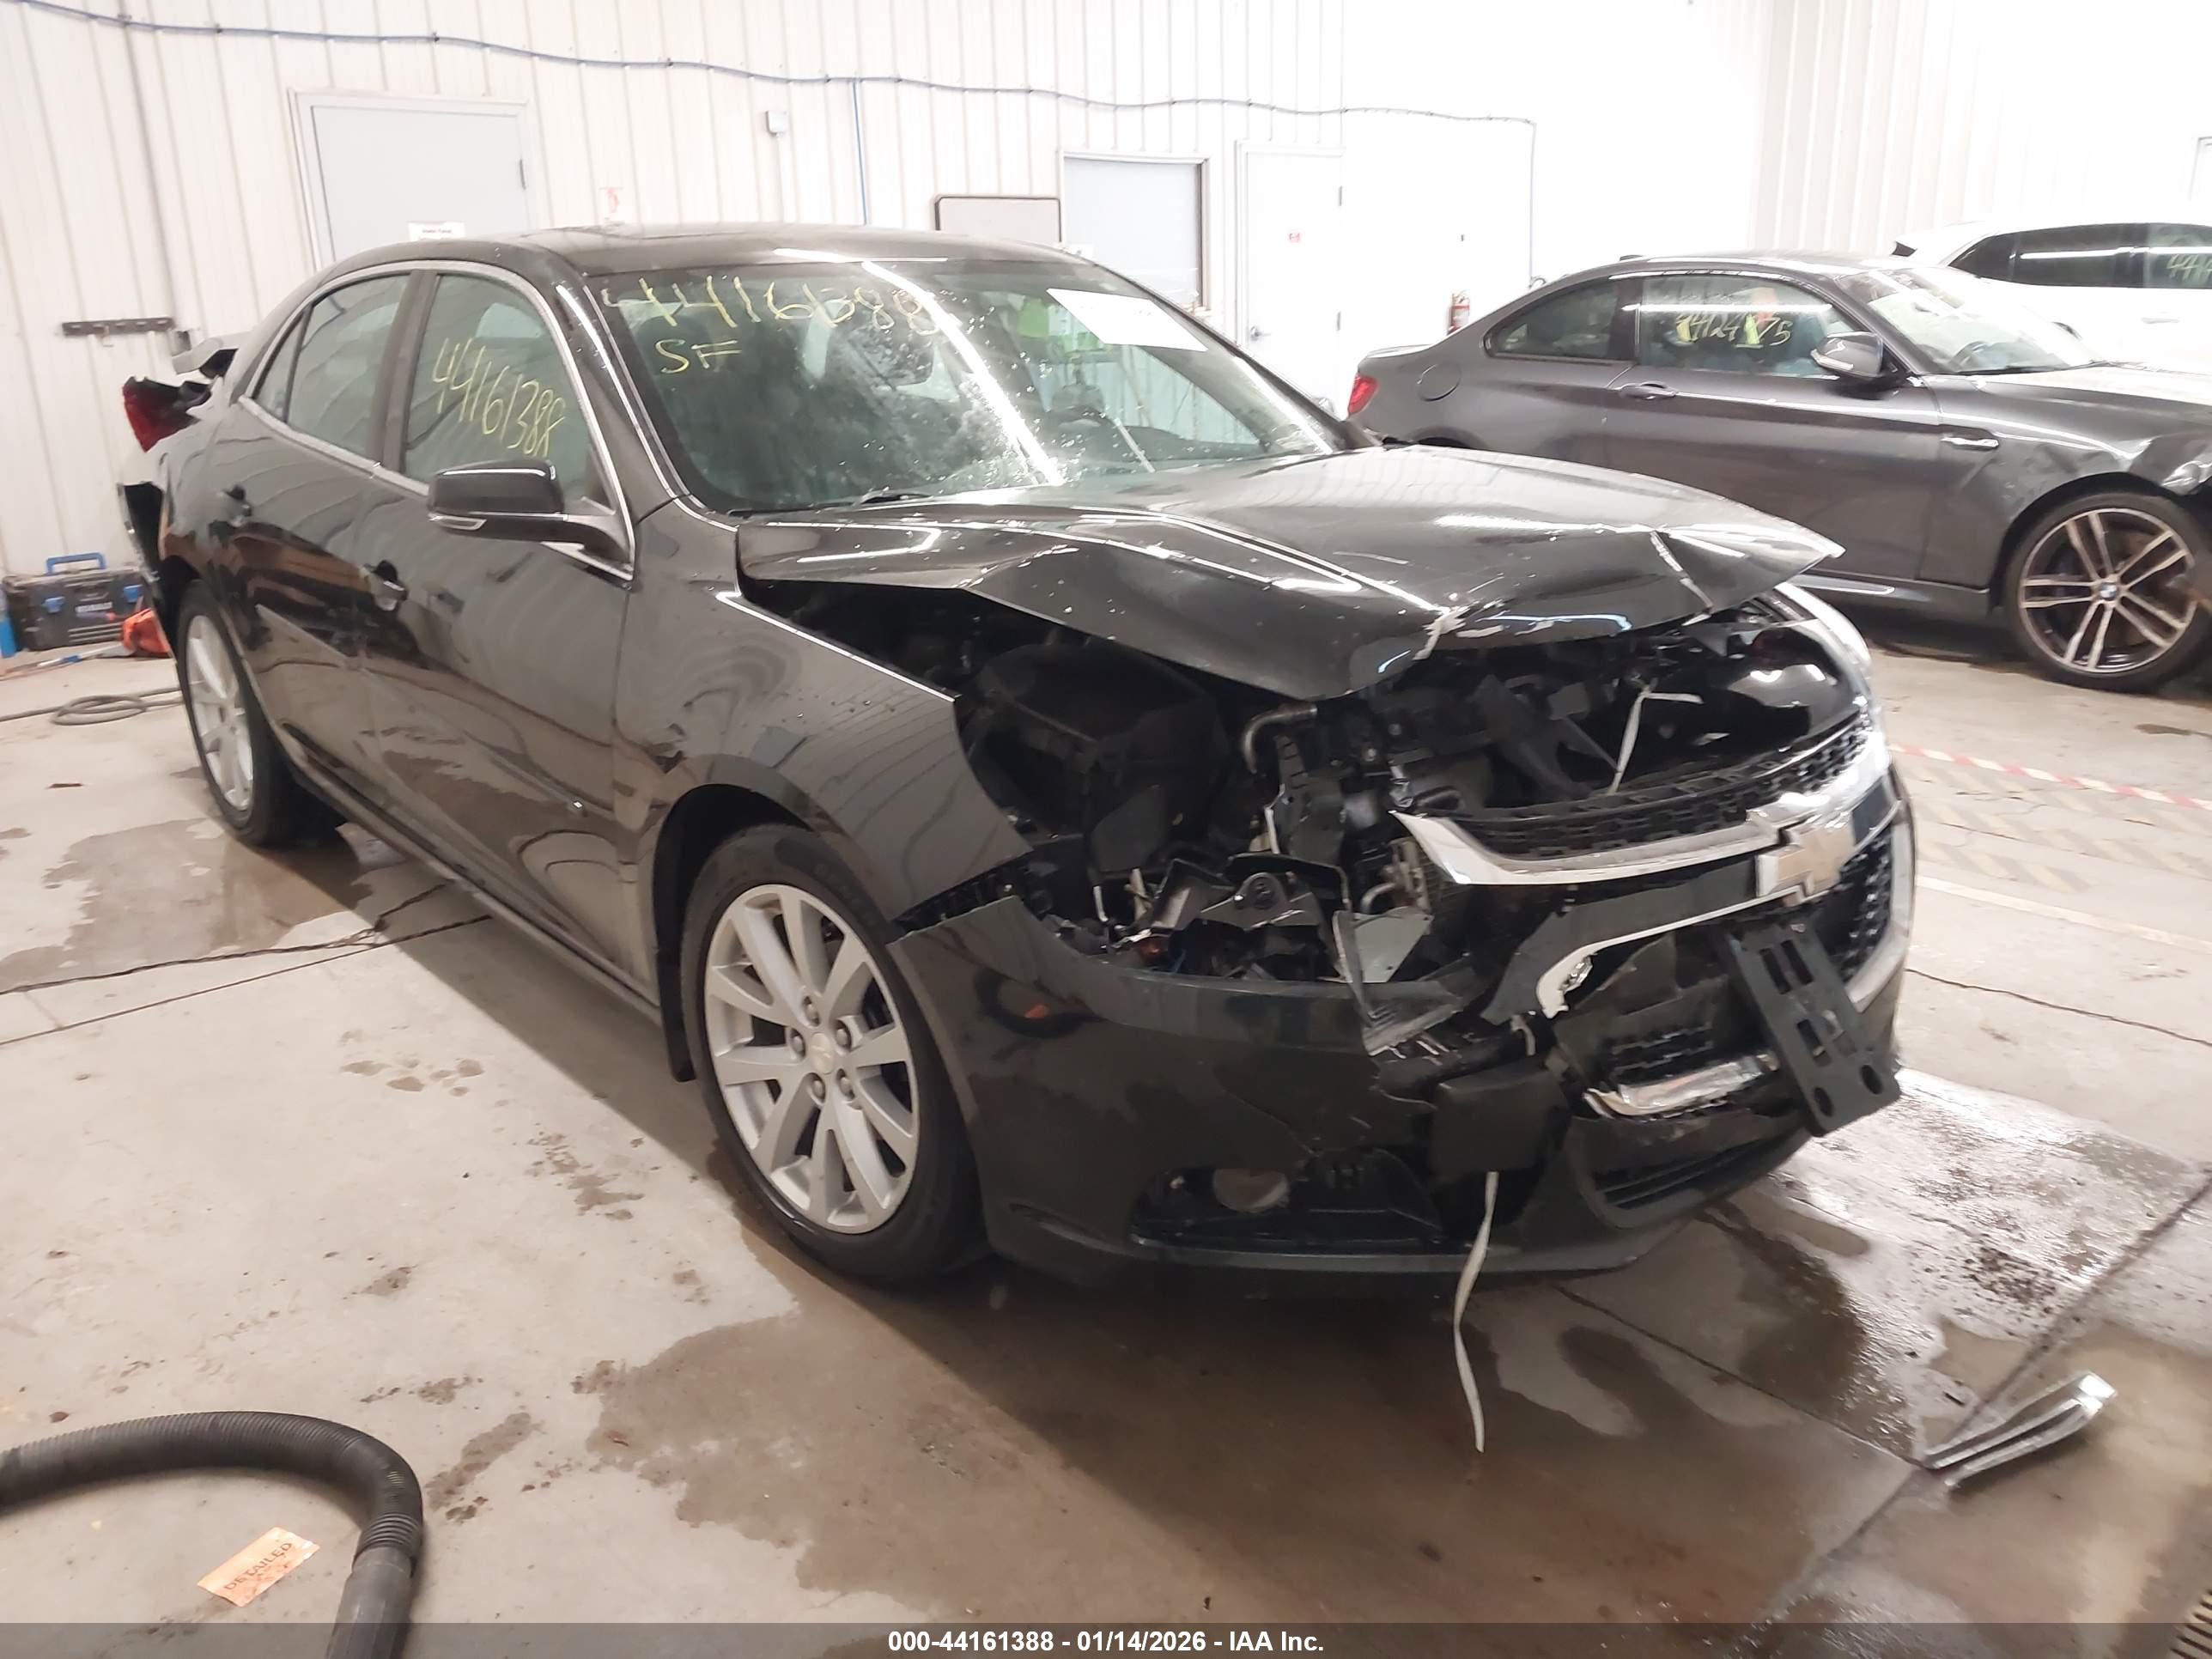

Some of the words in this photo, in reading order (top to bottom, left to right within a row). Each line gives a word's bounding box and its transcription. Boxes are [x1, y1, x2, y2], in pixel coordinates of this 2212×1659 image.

[655, 339, 742, 373] SF
[433, 337, 566, 457] 44161388
[224, 1542, 293, 1589] DETAILED
